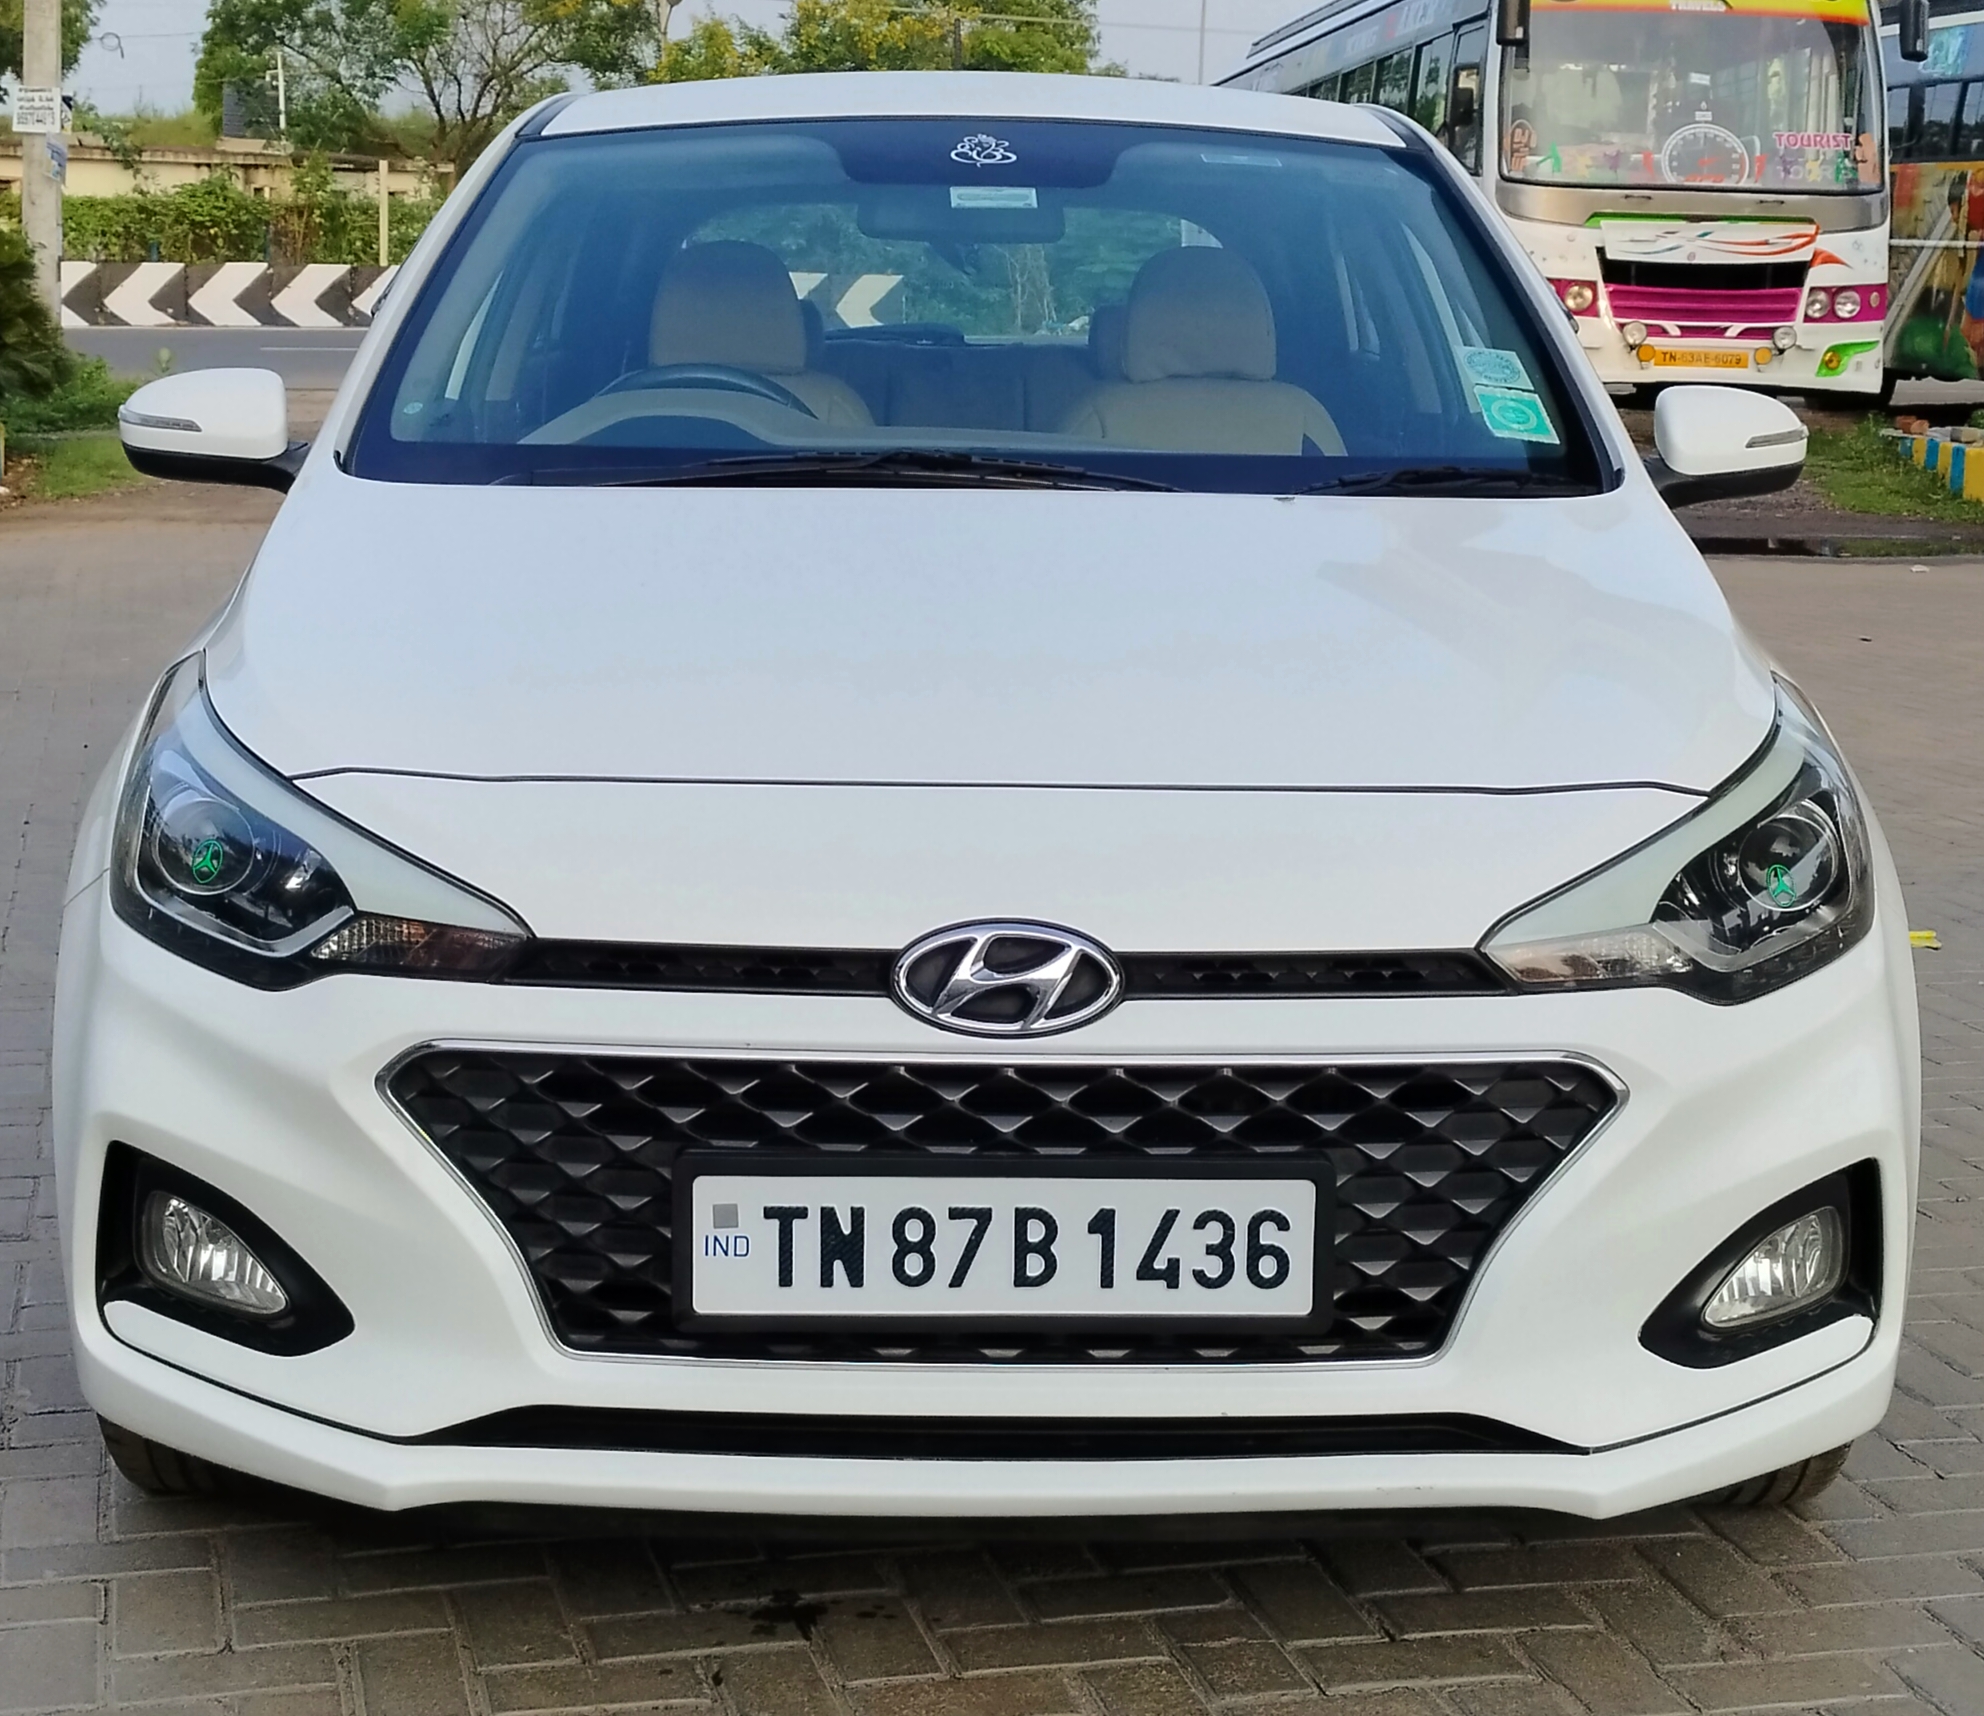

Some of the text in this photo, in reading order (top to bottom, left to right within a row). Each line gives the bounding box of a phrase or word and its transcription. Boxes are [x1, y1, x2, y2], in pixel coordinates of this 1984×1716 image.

[1773, 132, 1852, 150] TOURIST
[705, 1236, 749, 1256] IND
[764, 1207, 1290, 1289] TN 87 B 1436
